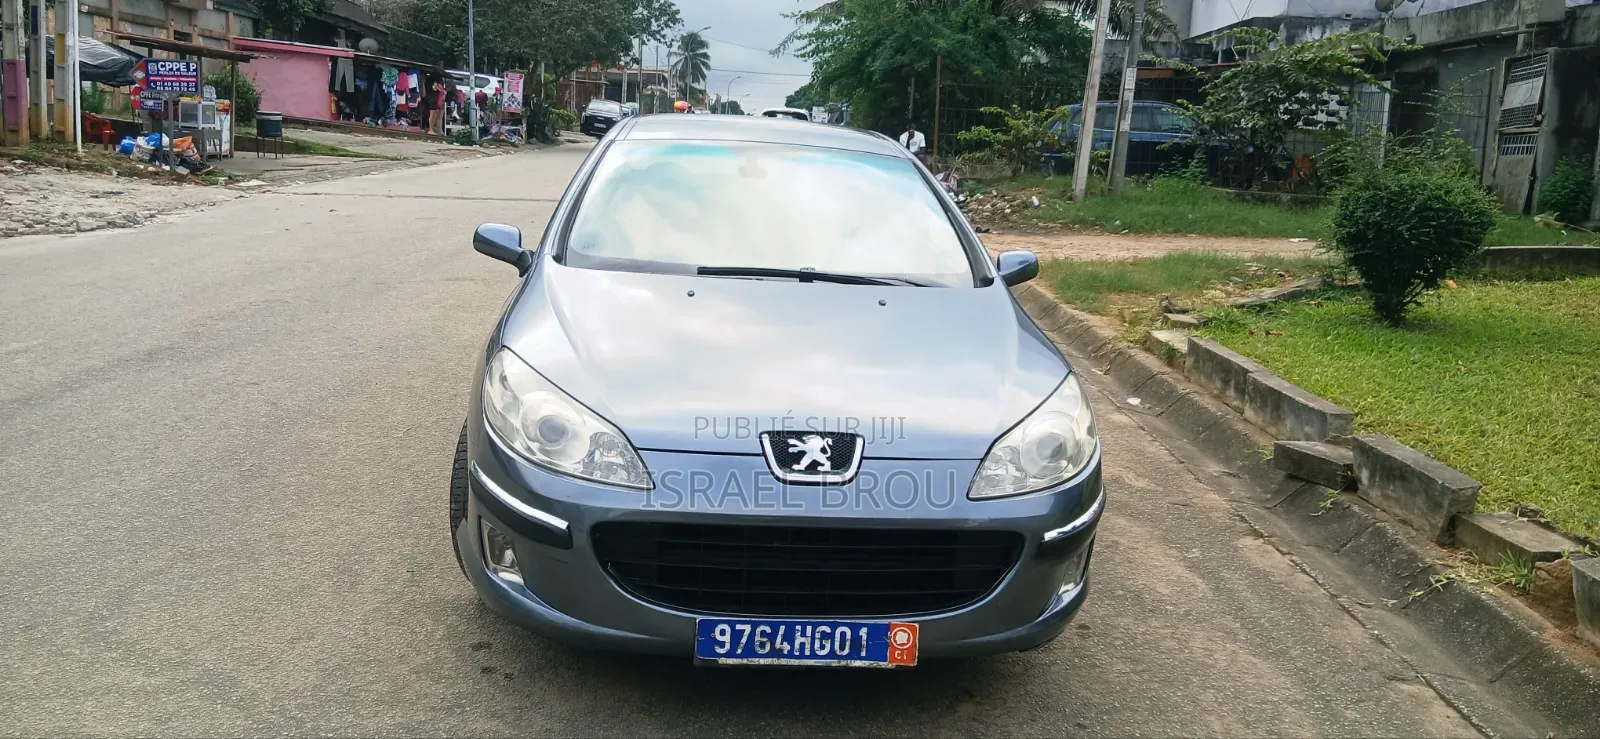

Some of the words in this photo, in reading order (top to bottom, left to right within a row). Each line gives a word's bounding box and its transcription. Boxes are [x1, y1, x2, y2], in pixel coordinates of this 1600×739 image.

[158, 62, 187, 71] CPPE
[190, 63, 196, 72] P
[714, 623, 868, 657] 9764HG01
